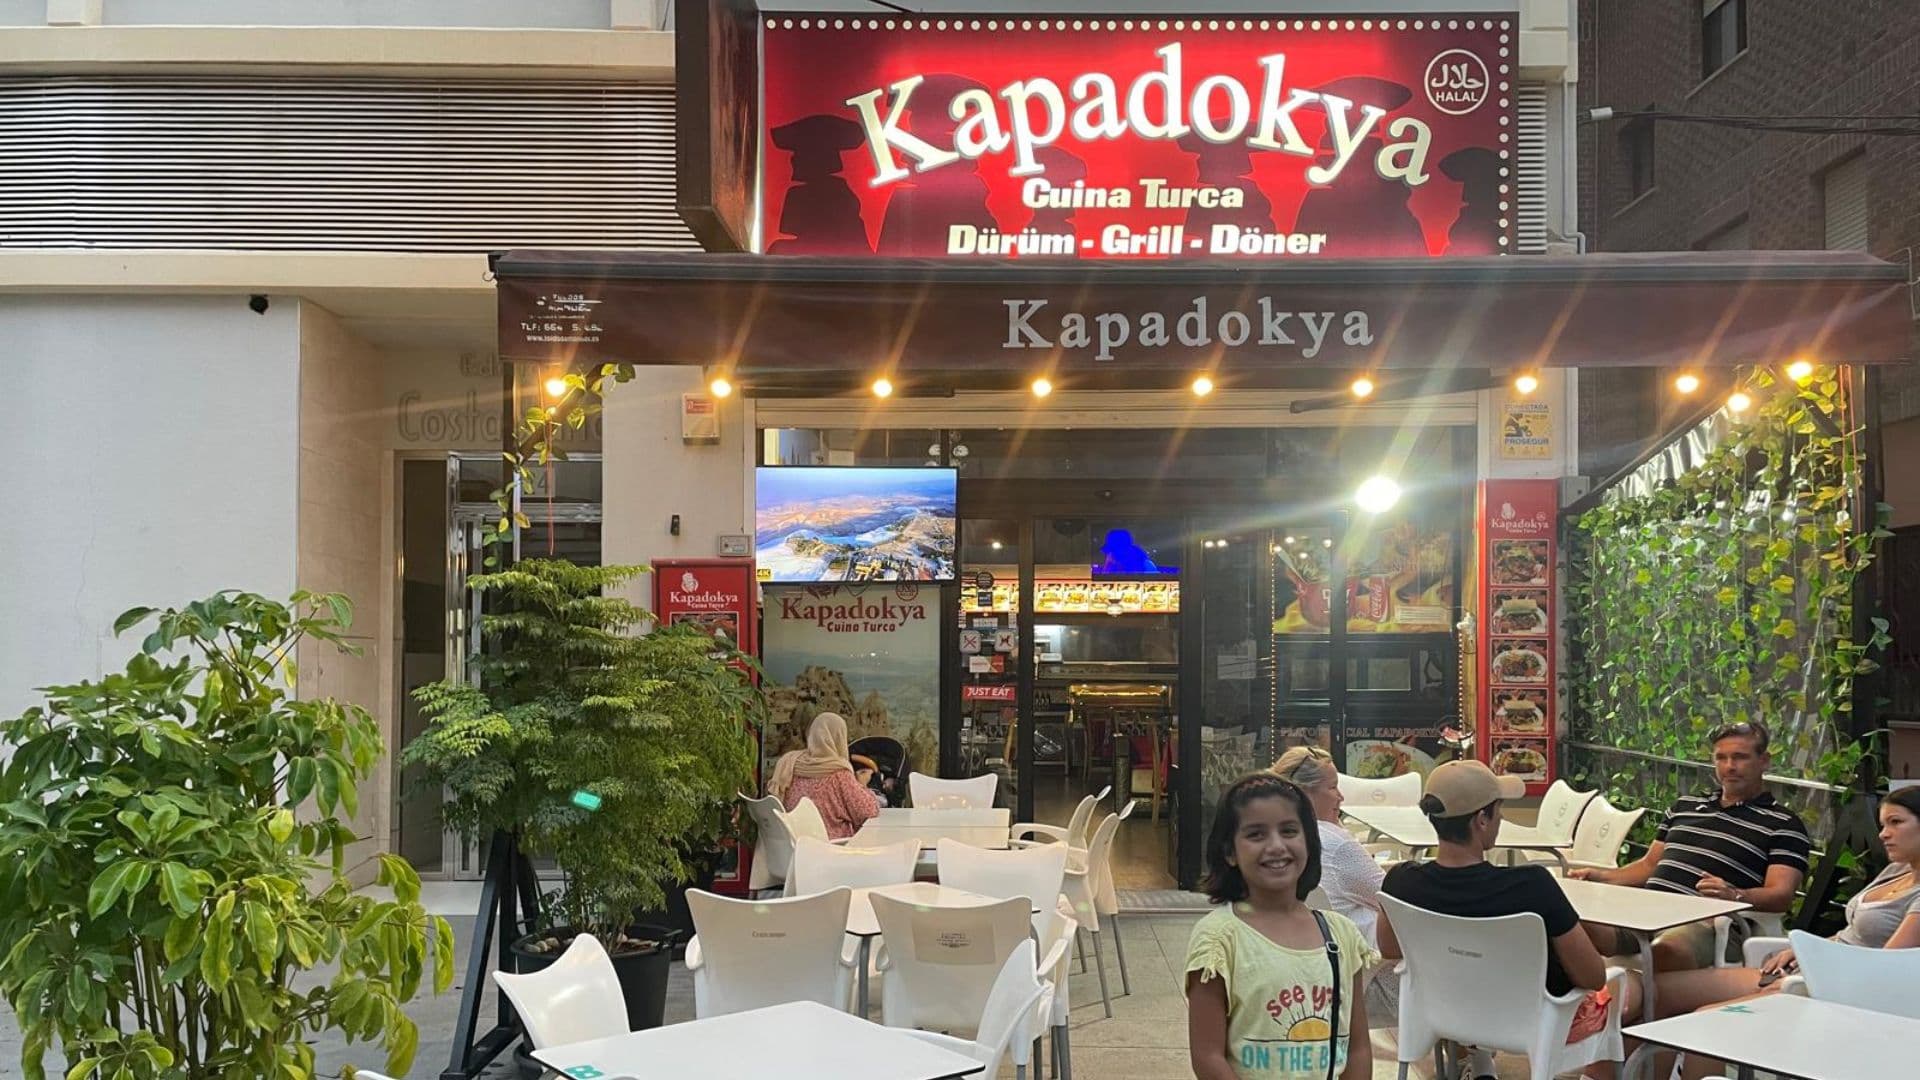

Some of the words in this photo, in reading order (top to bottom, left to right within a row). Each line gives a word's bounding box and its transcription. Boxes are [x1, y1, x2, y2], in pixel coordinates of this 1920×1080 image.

[1431, 63, 1484, 89] حلال
[1435, 91, 1479, 102] HALAL
[846, 42, 1431, 187] Kapadokya
[1022, 178, 1131, 209] Cuina
[1139, 178, 1244, 209] Turca
[947, 224, 1075, 255] Dürüm
[1102, 224, 1184, 255] Grill
[1210, 224, 1327, 255] Döner
[1002, 296, 1374, 361] Kapadokya
[1491, 519, 1549, 531] Kapadokya
[670, 591, 738, 606] Kapadokya
[781, 597, 925, 627] Kapadokya
[968, 687, 991, 697] JUST
[992, 687, 1010, 696] EAT
[1266, 985, 1305, 1017] see
[1241, 1045, 1270, 1069] ON
[1278, 1046, 1314, 1072] THE
